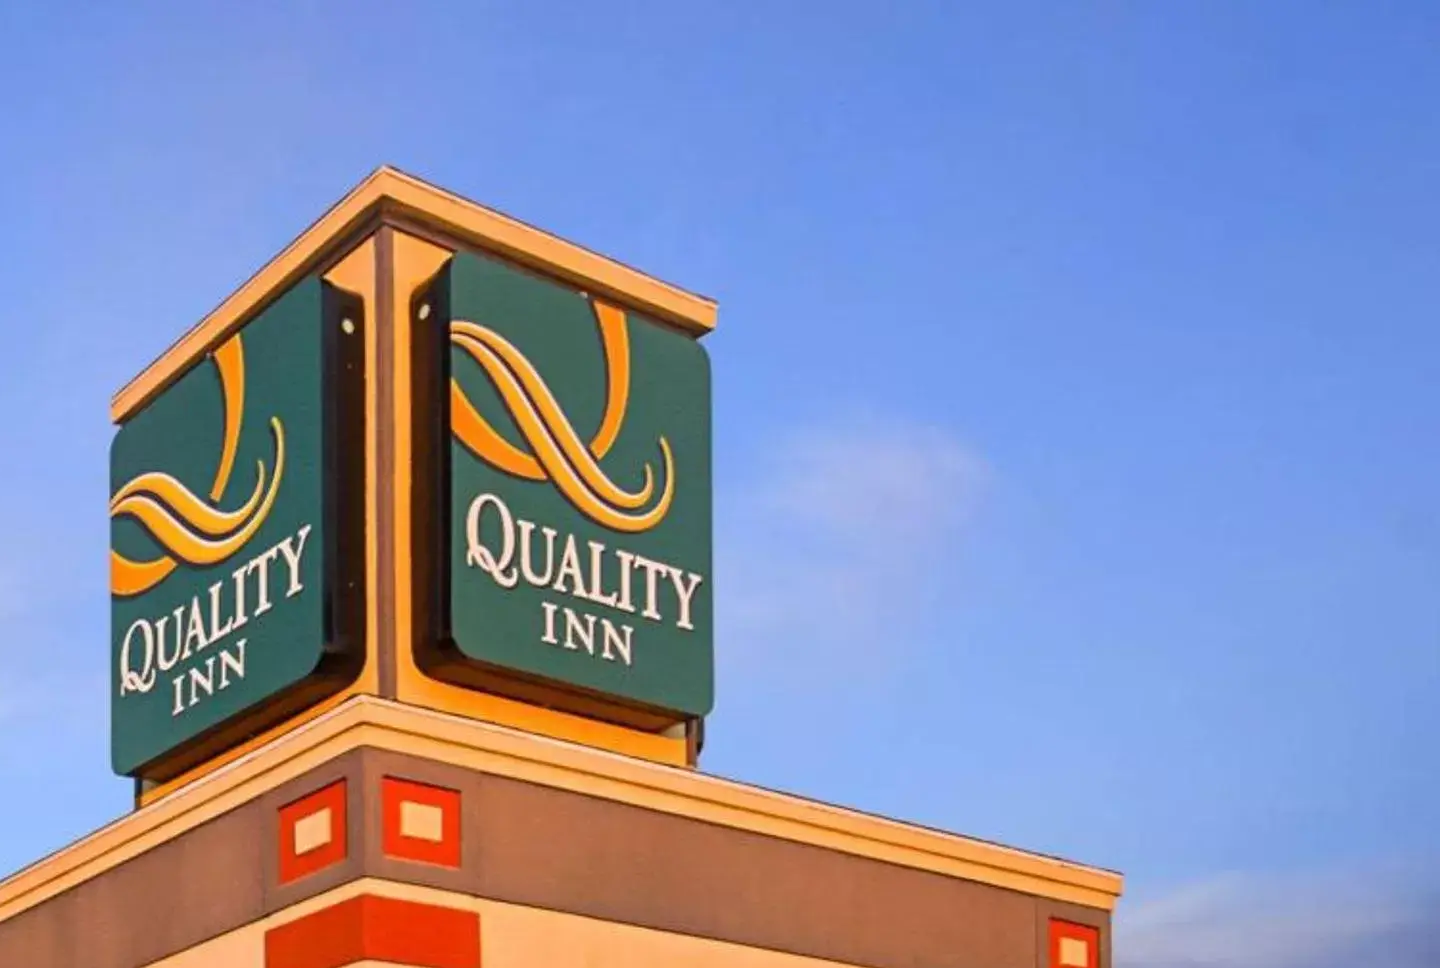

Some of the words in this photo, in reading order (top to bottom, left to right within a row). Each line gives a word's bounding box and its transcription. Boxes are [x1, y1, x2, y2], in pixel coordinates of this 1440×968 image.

[119, 523, 312, 696] QUALITY
[466, 492, 703, 631] QUALITY
[170, 638, 248, 716] INN
[540, 601, 635, 666] INN
